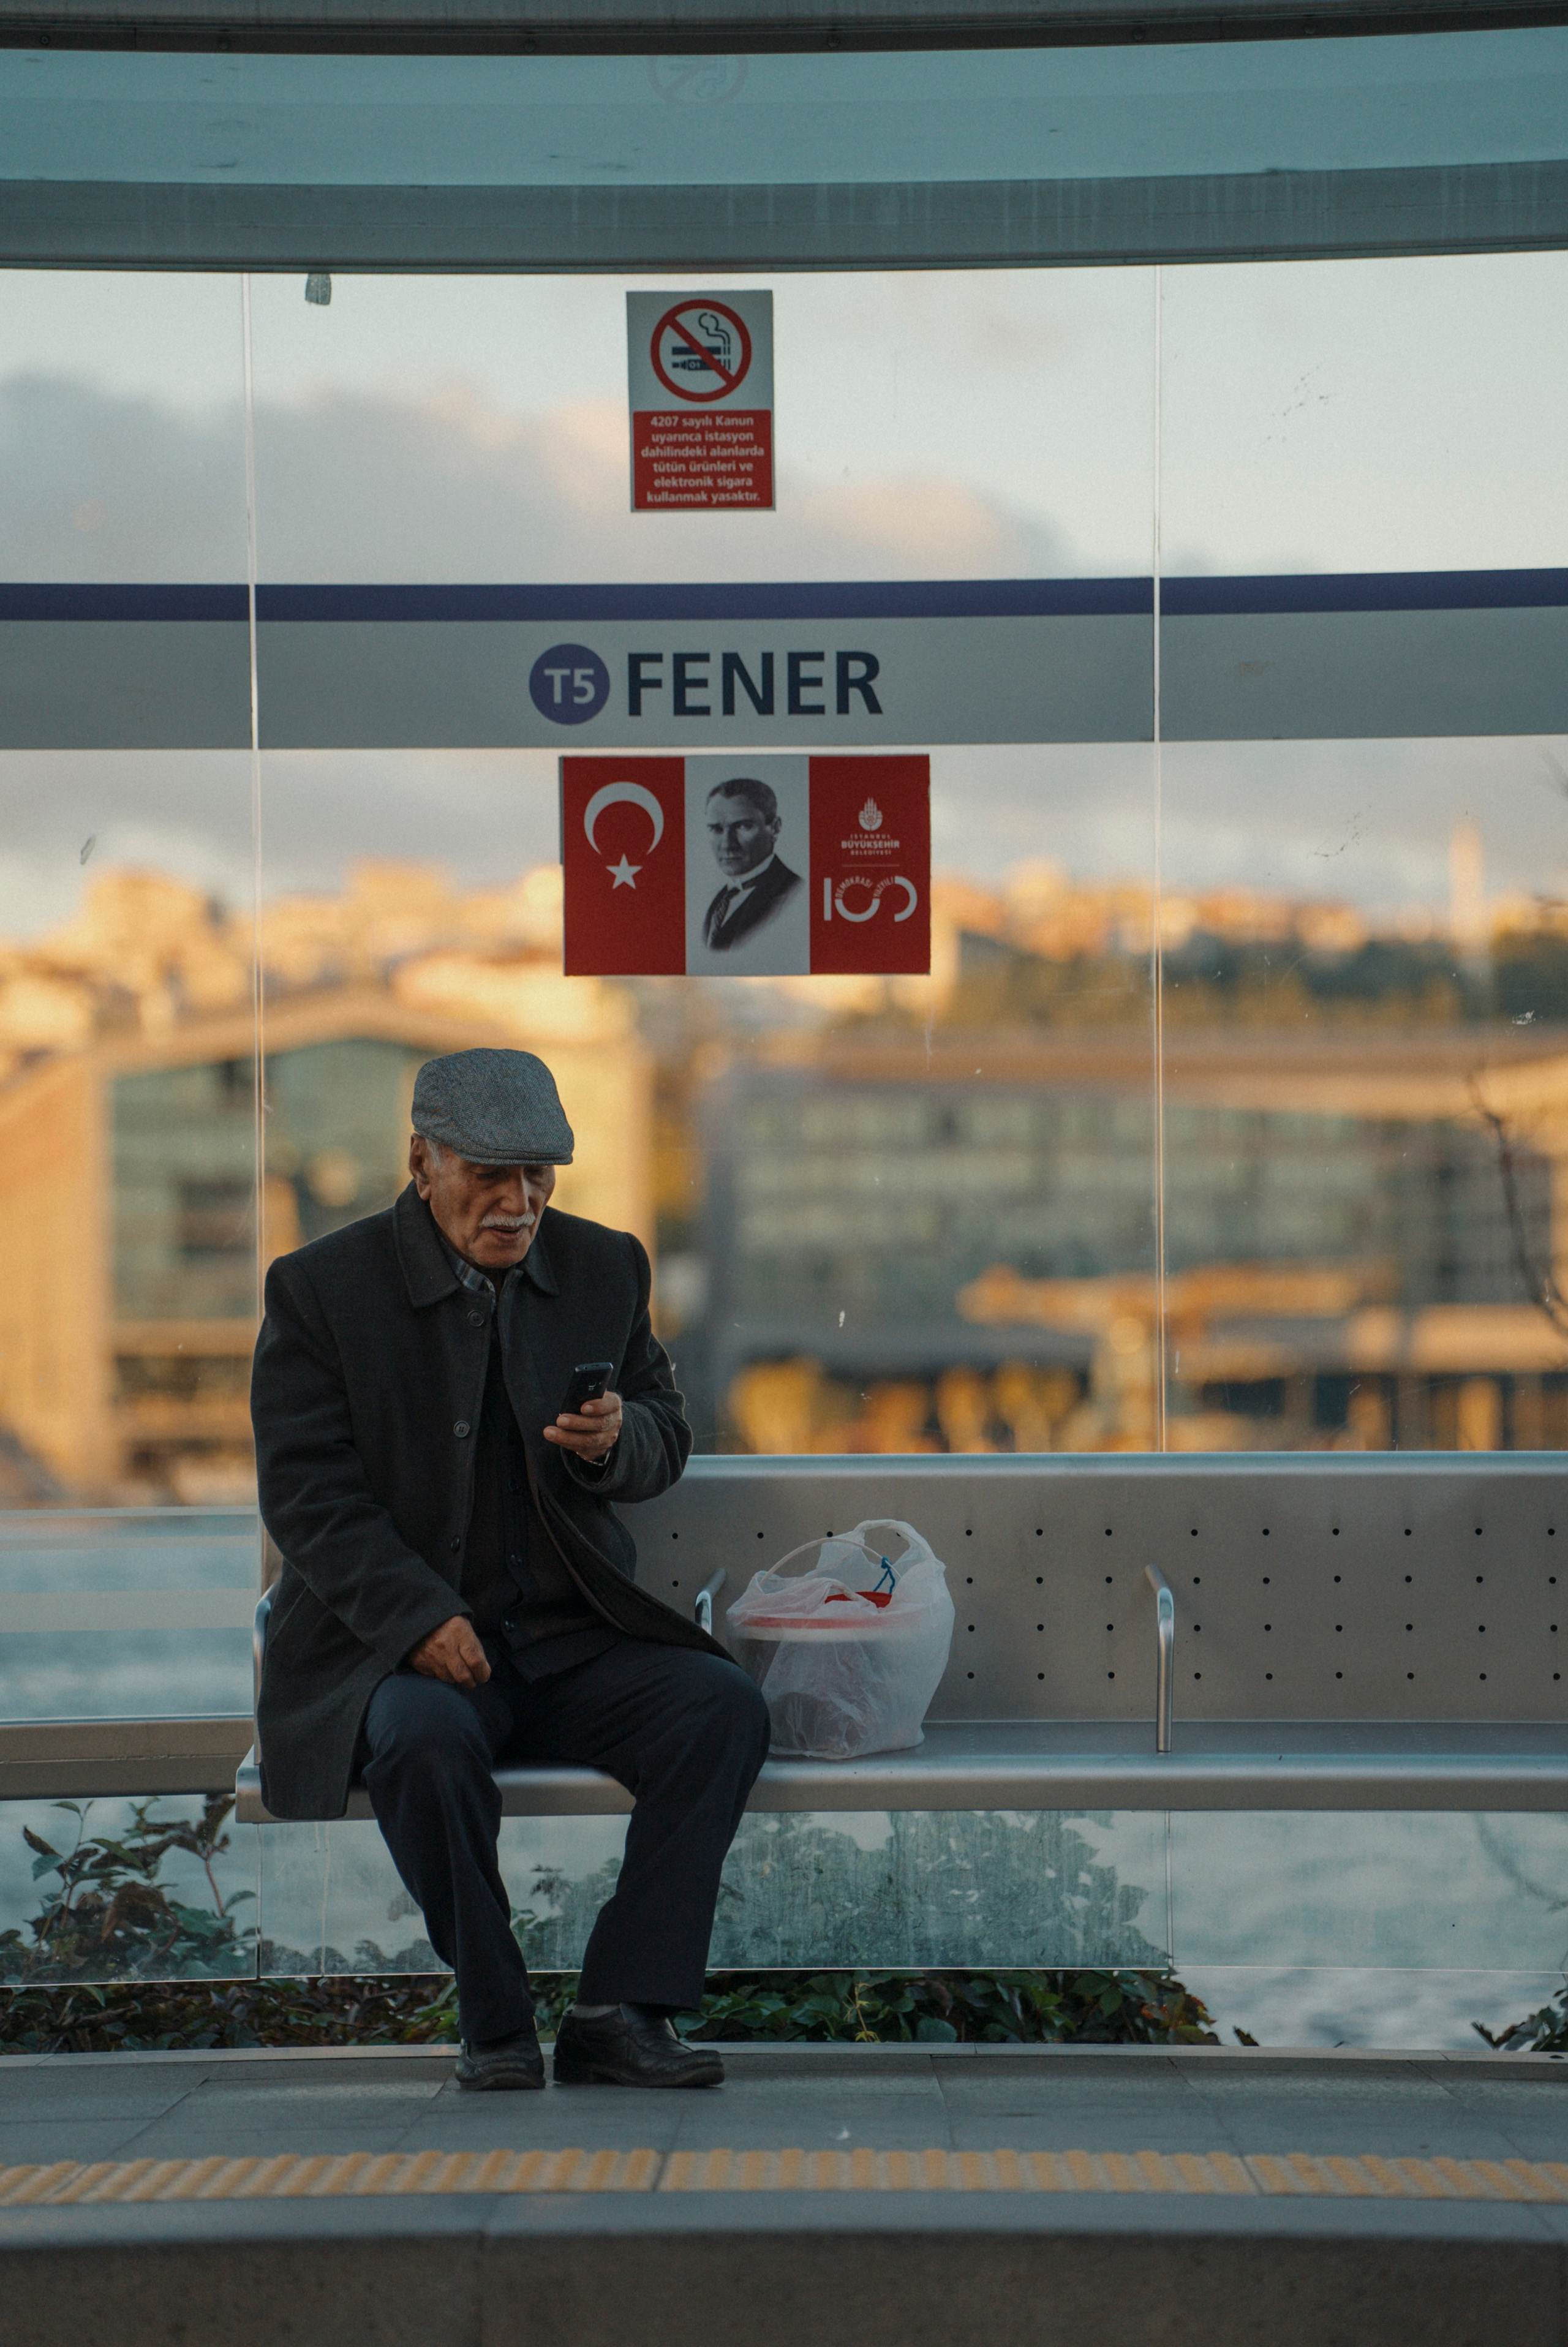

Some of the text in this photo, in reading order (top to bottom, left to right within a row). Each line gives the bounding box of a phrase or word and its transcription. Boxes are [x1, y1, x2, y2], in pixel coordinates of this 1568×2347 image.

[650, 415, 754, 429] 4207 sayılı Kanun
[652, 431, 754, 444] uyarınca istasyon
[641, 445, 764, 457] dahilindeki alanlarda
[653, 461, 753, 472] tütün ürünleri ve
[654, 475, 753, 489] elektronik sigara
[647, 491, 760, 504] kullanmak yasaktır.
[544, 651, 883, 716] T5 FENER
